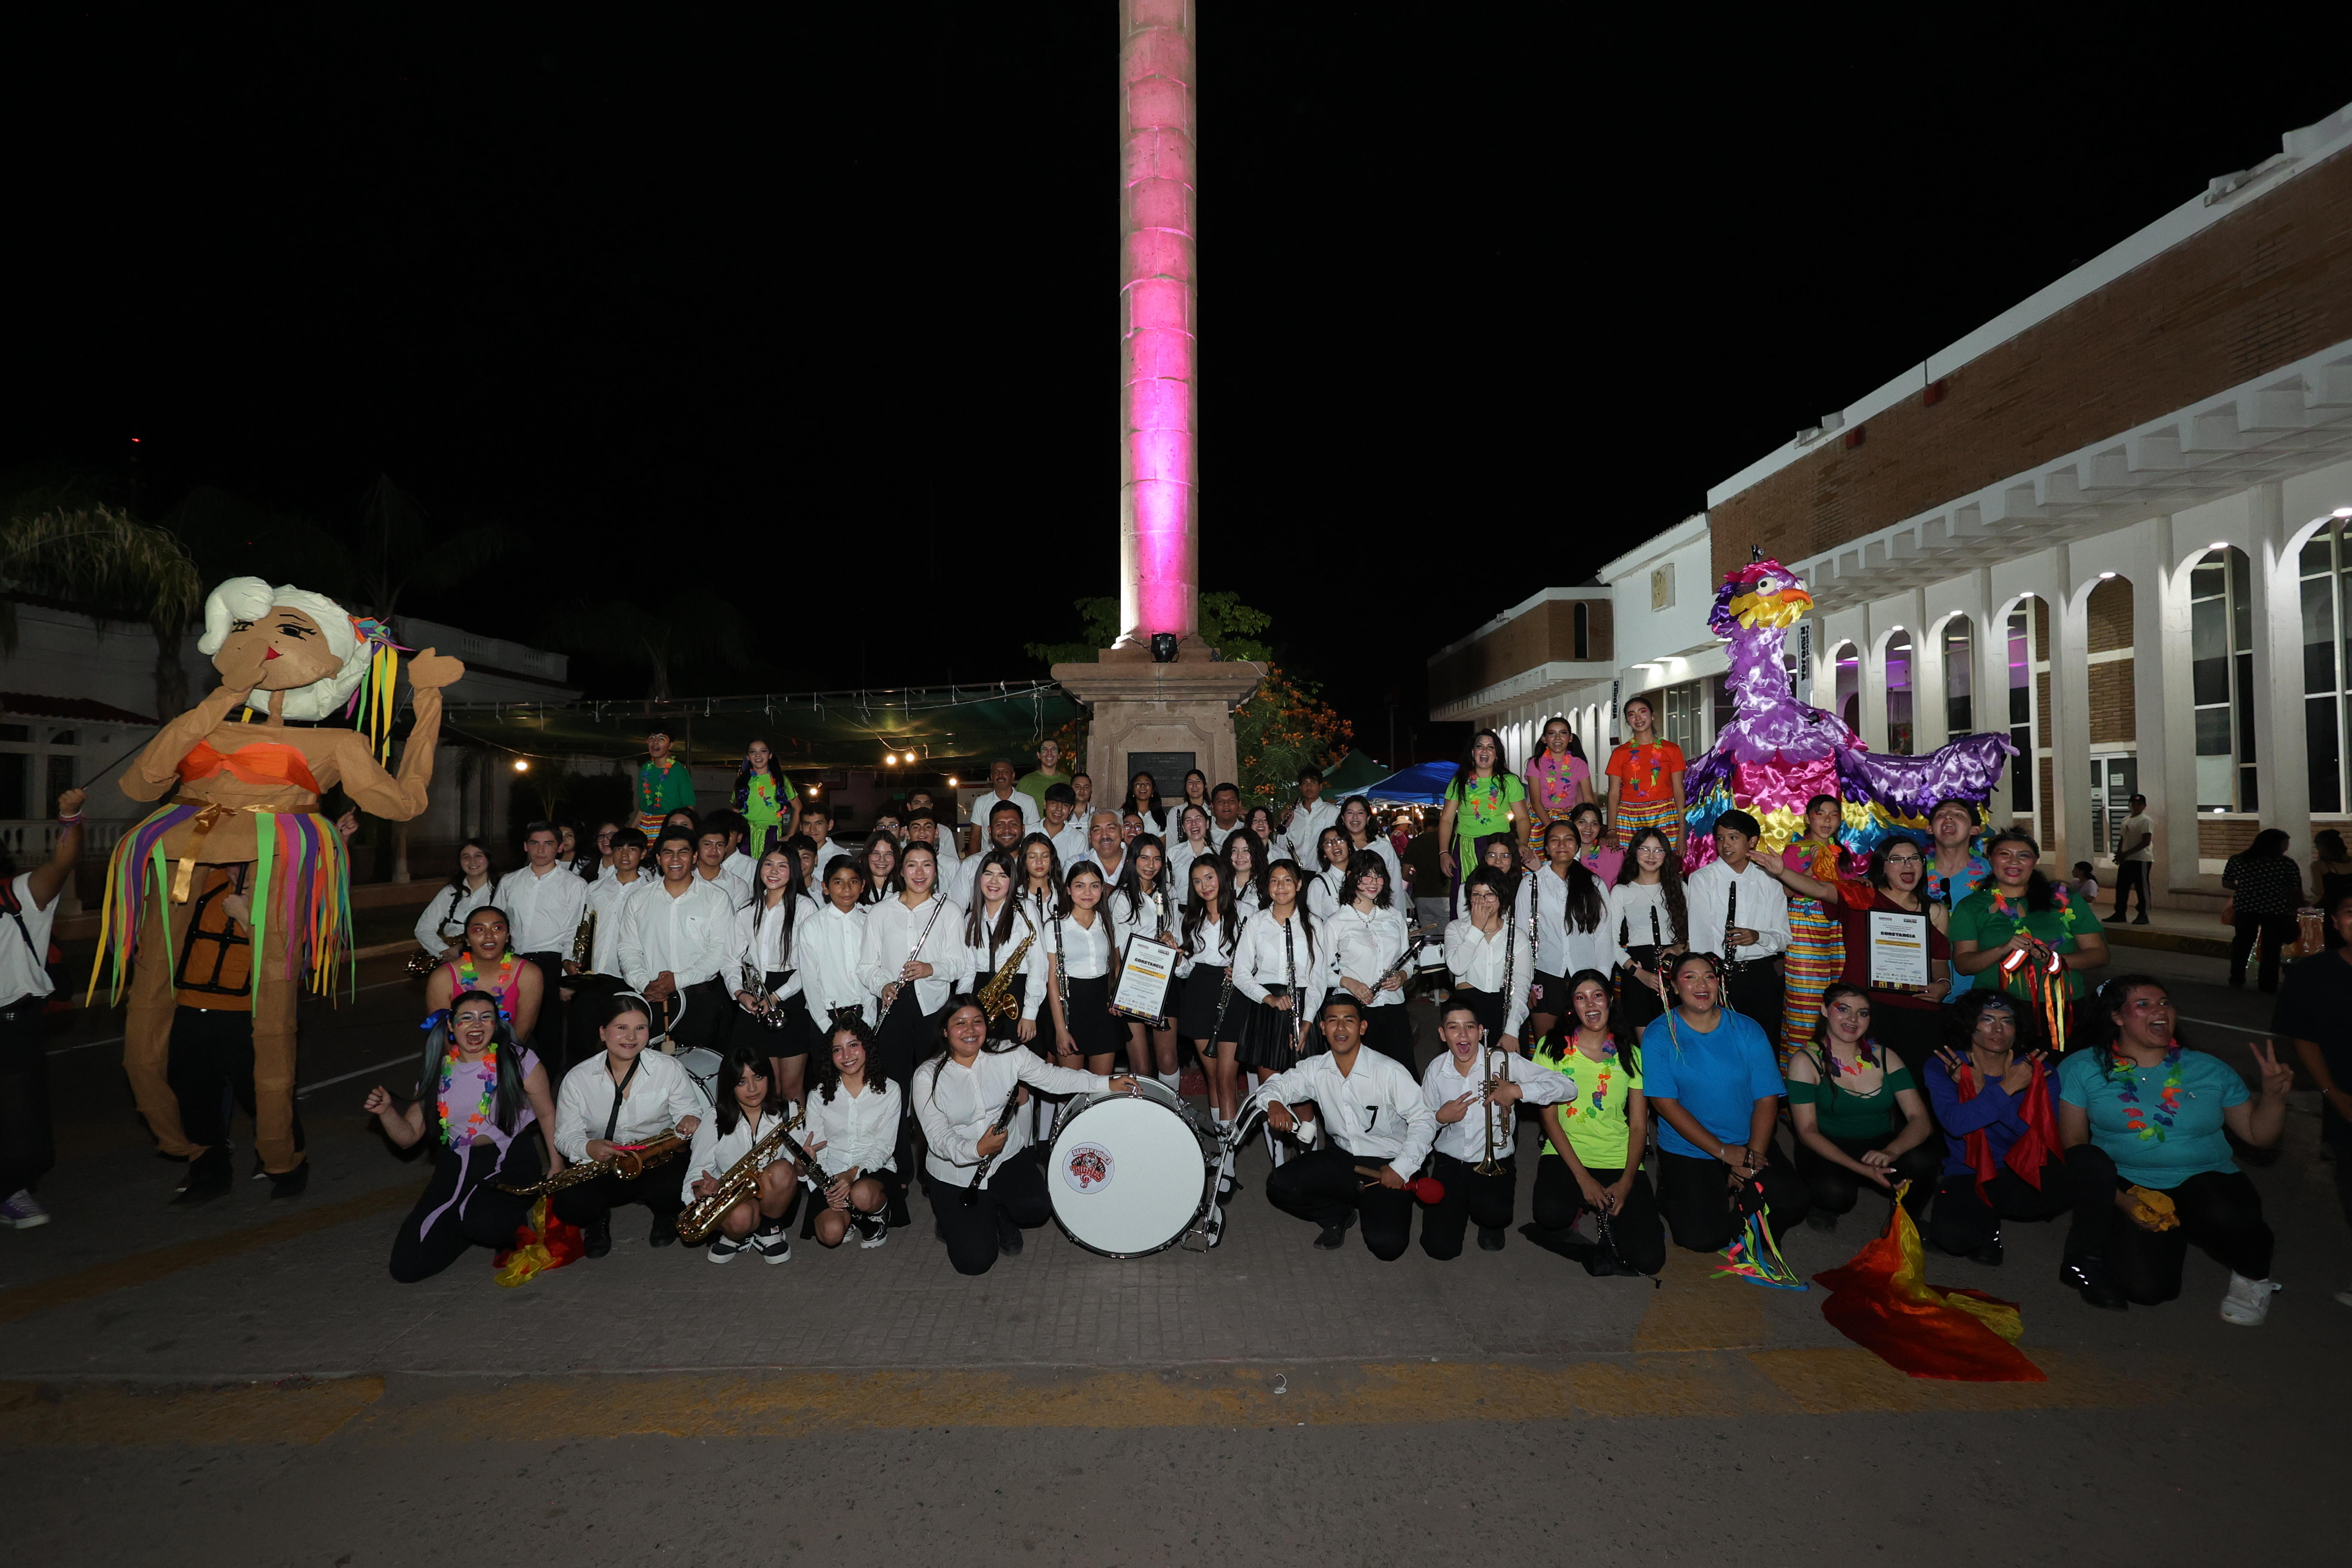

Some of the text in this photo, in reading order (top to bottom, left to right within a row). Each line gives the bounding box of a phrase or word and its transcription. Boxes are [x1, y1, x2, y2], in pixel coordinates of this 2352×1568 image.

[1135, 958, 1164, 970] CONSTANCIA
[1094, 1150, 1112, 1165] MÚSICA
[1070, 1165, 1106, 1182] TIGRES
